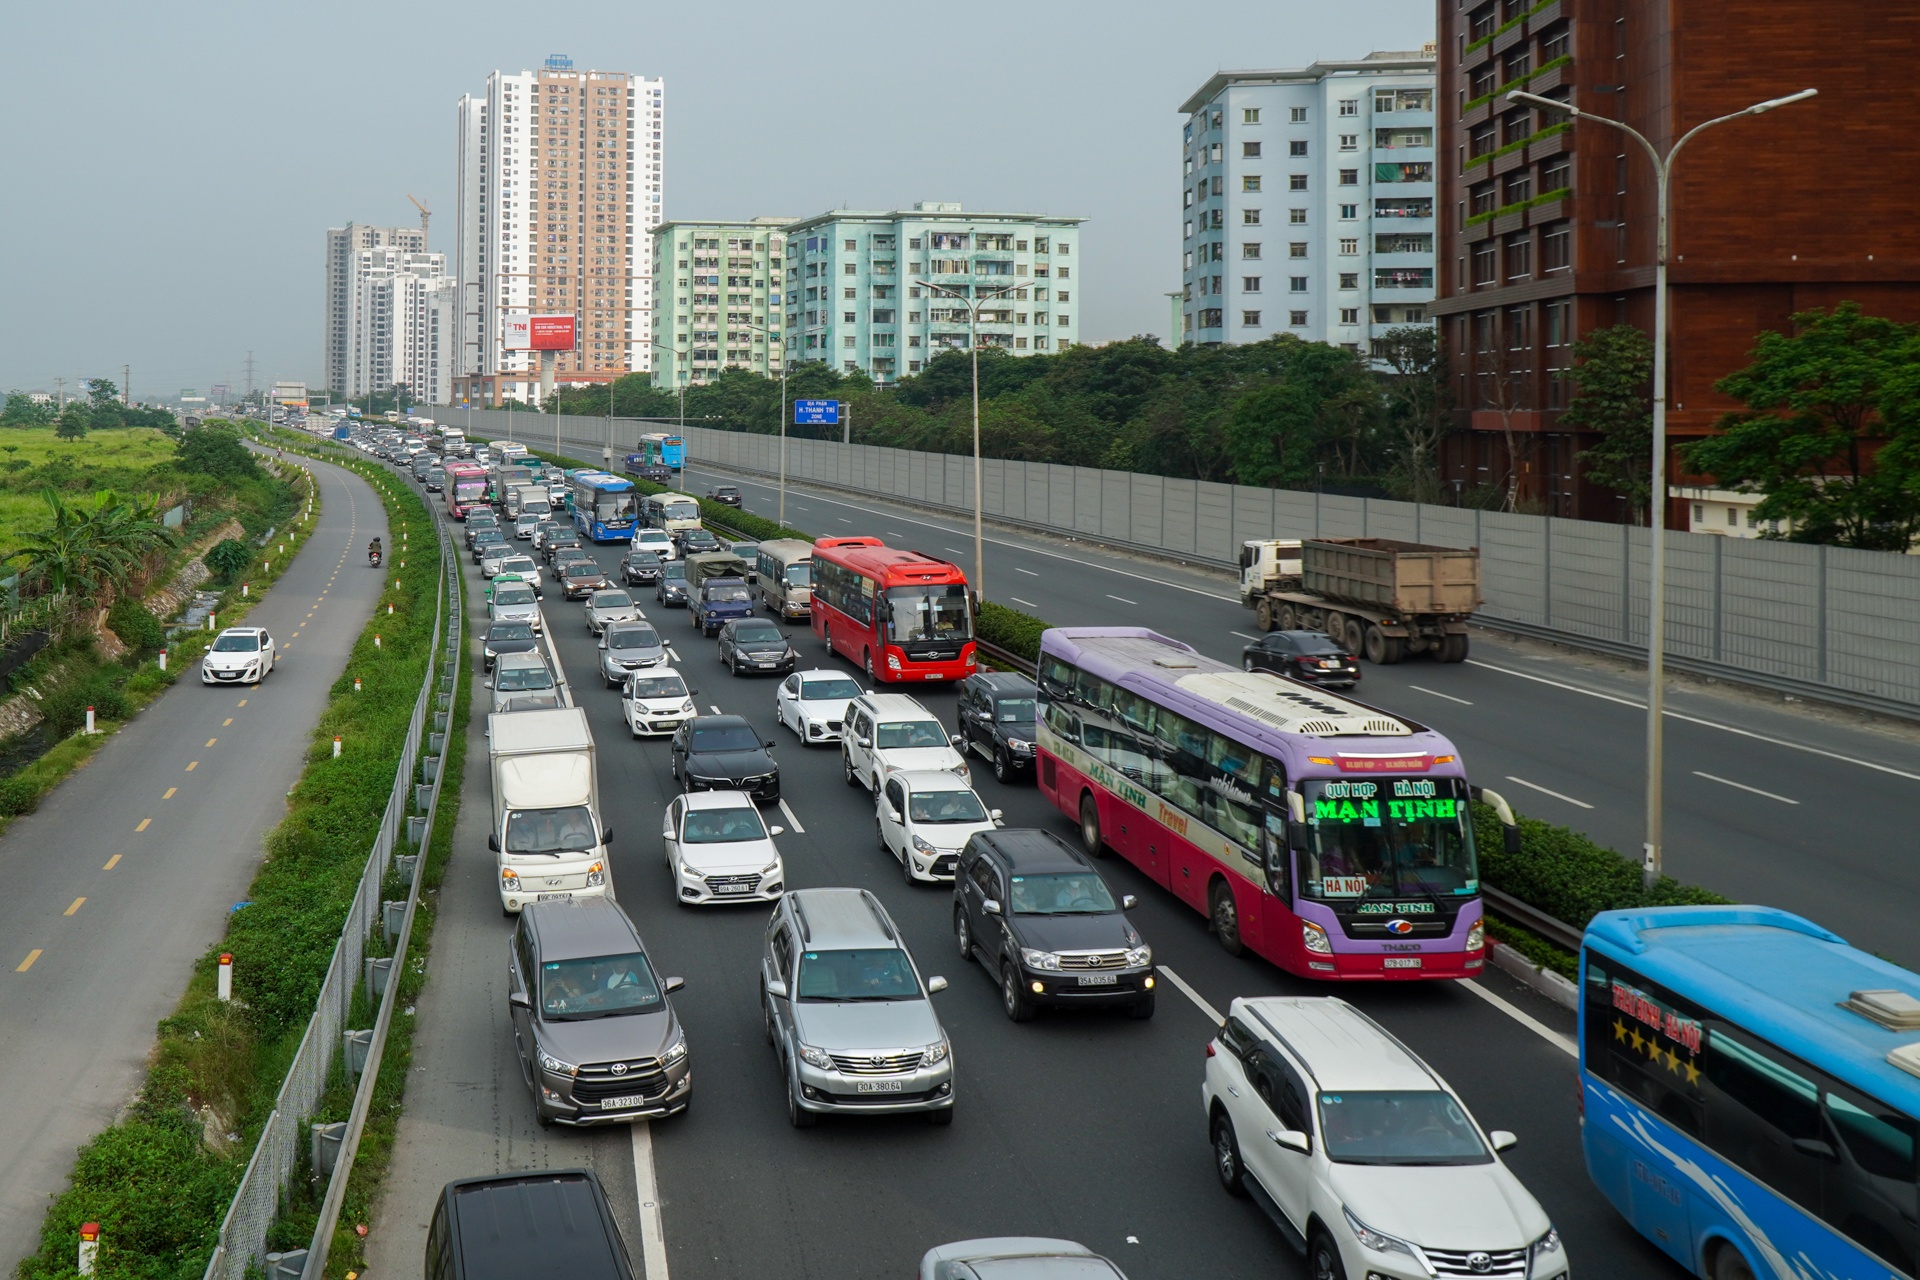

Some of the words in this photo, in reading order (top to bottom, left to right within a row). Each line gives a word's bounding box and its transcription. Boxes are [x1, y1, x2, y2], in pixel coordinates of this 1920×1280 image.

[1325, 780, 1350, 799] QUỲ
[1351, 782, 1377, 799] HỢP
[1394, 779, 1413, 796] HÀ
[1413, 779, 1436, 798] NỘI
[1159, 801, 1188, 836] Travel
[1326, 877, 1341, 892] HÀ
[1345, 876, 1365, 895] NỘI
[1381, 943, 1421, 952] THACO
